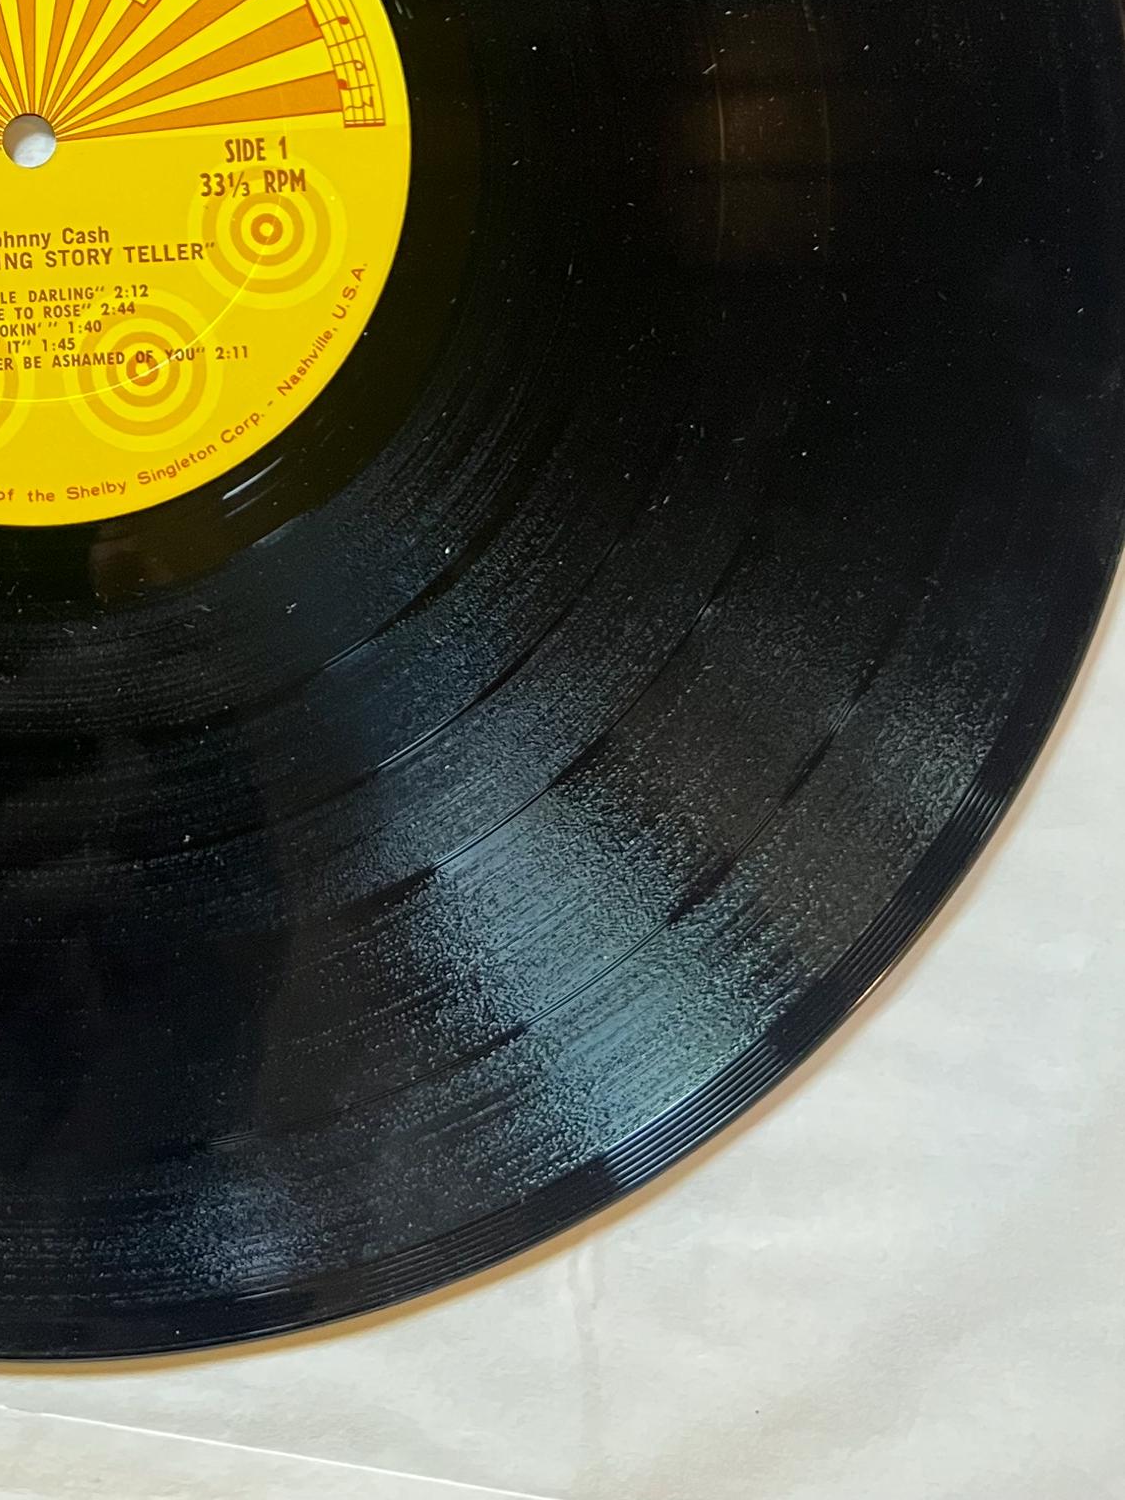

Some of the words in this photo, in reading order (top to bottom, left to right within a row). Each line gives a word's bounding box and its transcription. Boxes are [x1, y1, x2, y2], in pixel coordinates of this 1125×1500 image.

[225, 138, 266, 163] SIDE
[279, 136, 287, 160] 1
[263, 168, 306, 193] RPM
[62, 226, 109, 245] Cash
[45, 248, 113, 268] STORY
[123, 242, 215, 263] TELLER"
[28, 286, 104, 303] DARLING"
[114, 284, 149, 299] 2:12
[14, 307, 33, 320] TO
[43, 303, 91, 318] ROSE"
[100, 302, 135, 316] 2:44
[68, 320, 102, 334] 1:40
[7, 340, 31, 354] IT"
[42, 338, 75, 351] 1:45
[23, 356, 42, 369] BE
[52, 352, 125, 368] ASHAMED
[135, 350, 153, 363] OF
[215, 346, 248, 360] 2:11
[28, 489, 55, 502] the
[67, 481, 126, 500] Shelby
[137, 443, 217, 485] Singleton
[220, 411, 264, 444] Corp.
